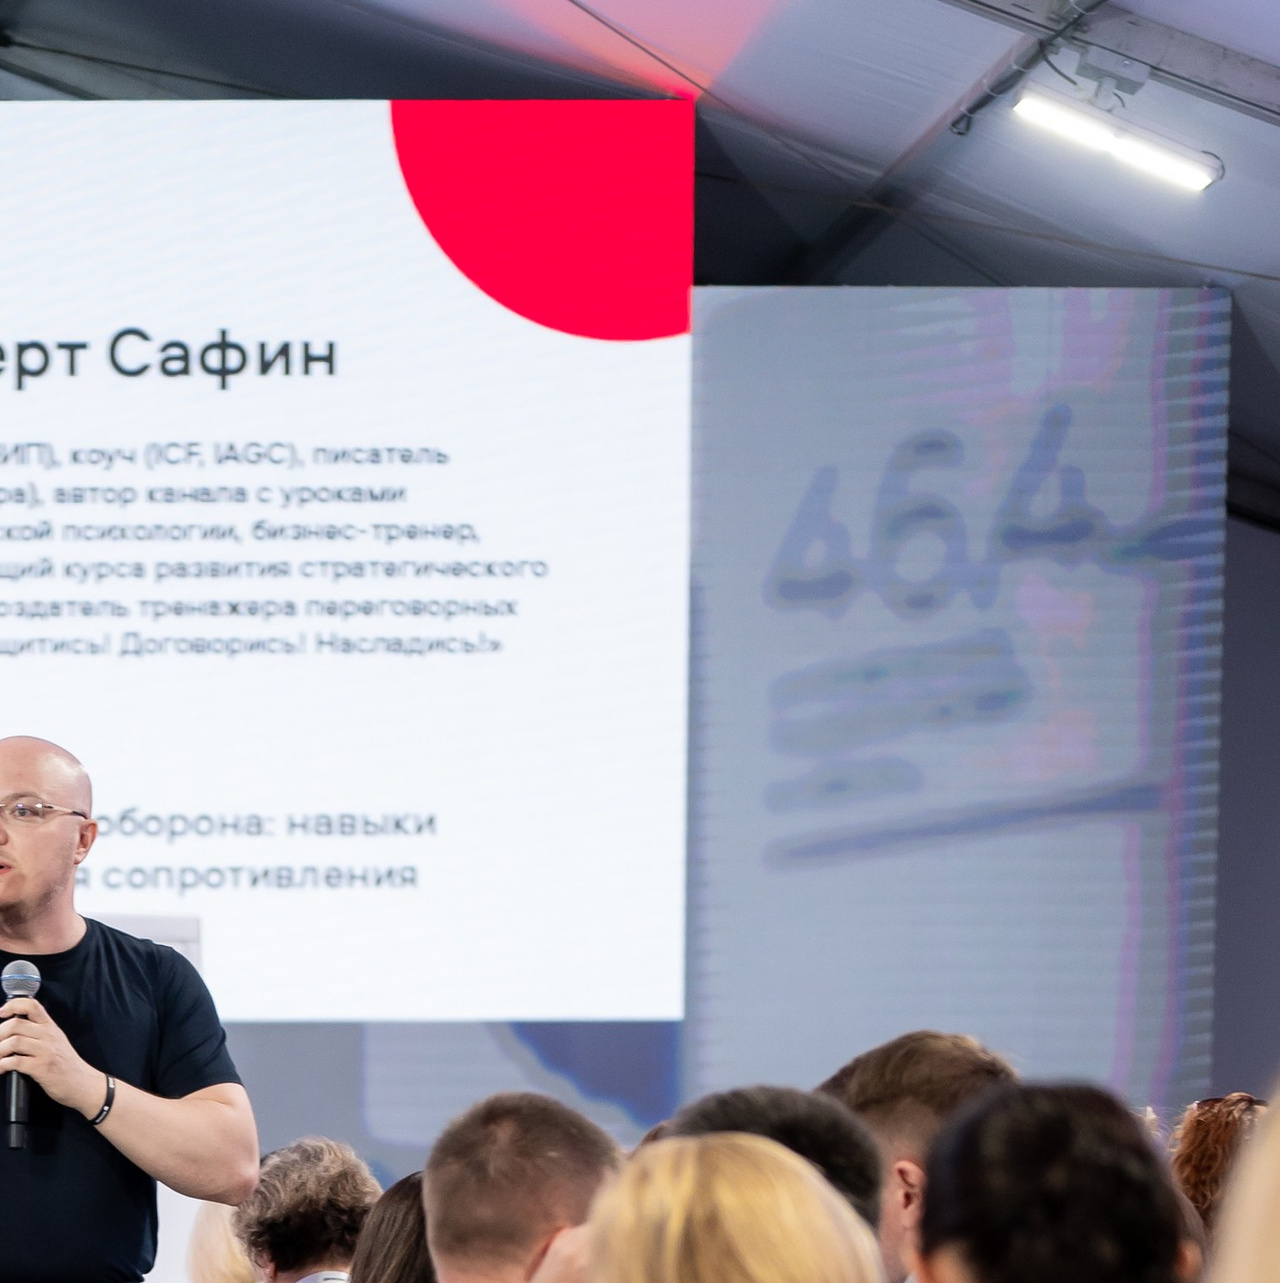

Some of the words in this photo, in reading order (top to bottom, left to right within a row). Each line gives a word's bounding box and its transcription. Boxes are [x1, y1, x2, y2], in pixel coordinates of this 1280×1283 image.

[109, 327, 335, 391] Сафин
[69, 447, 137, 471] коуч
[312, 446, 452, 465] писатель
[53, 486, 138, 508] автор
[145, 485, 249, 504] канала
[255, 486, 272, 504] с
[279, 486, 407, 509] уроками
[62, 522, 243, 545] психологии,
[62, 561, 147, 584] курса
[154, 560, 292, 583] развития
[299, 560, 549, 583] стратегического
[305, 599, 518, 621] переговорных
[119, 631, 306, 659] Договорись!
[286, 812, 438, 838] навыки
[102, 865, 419, 898] сопротивления
